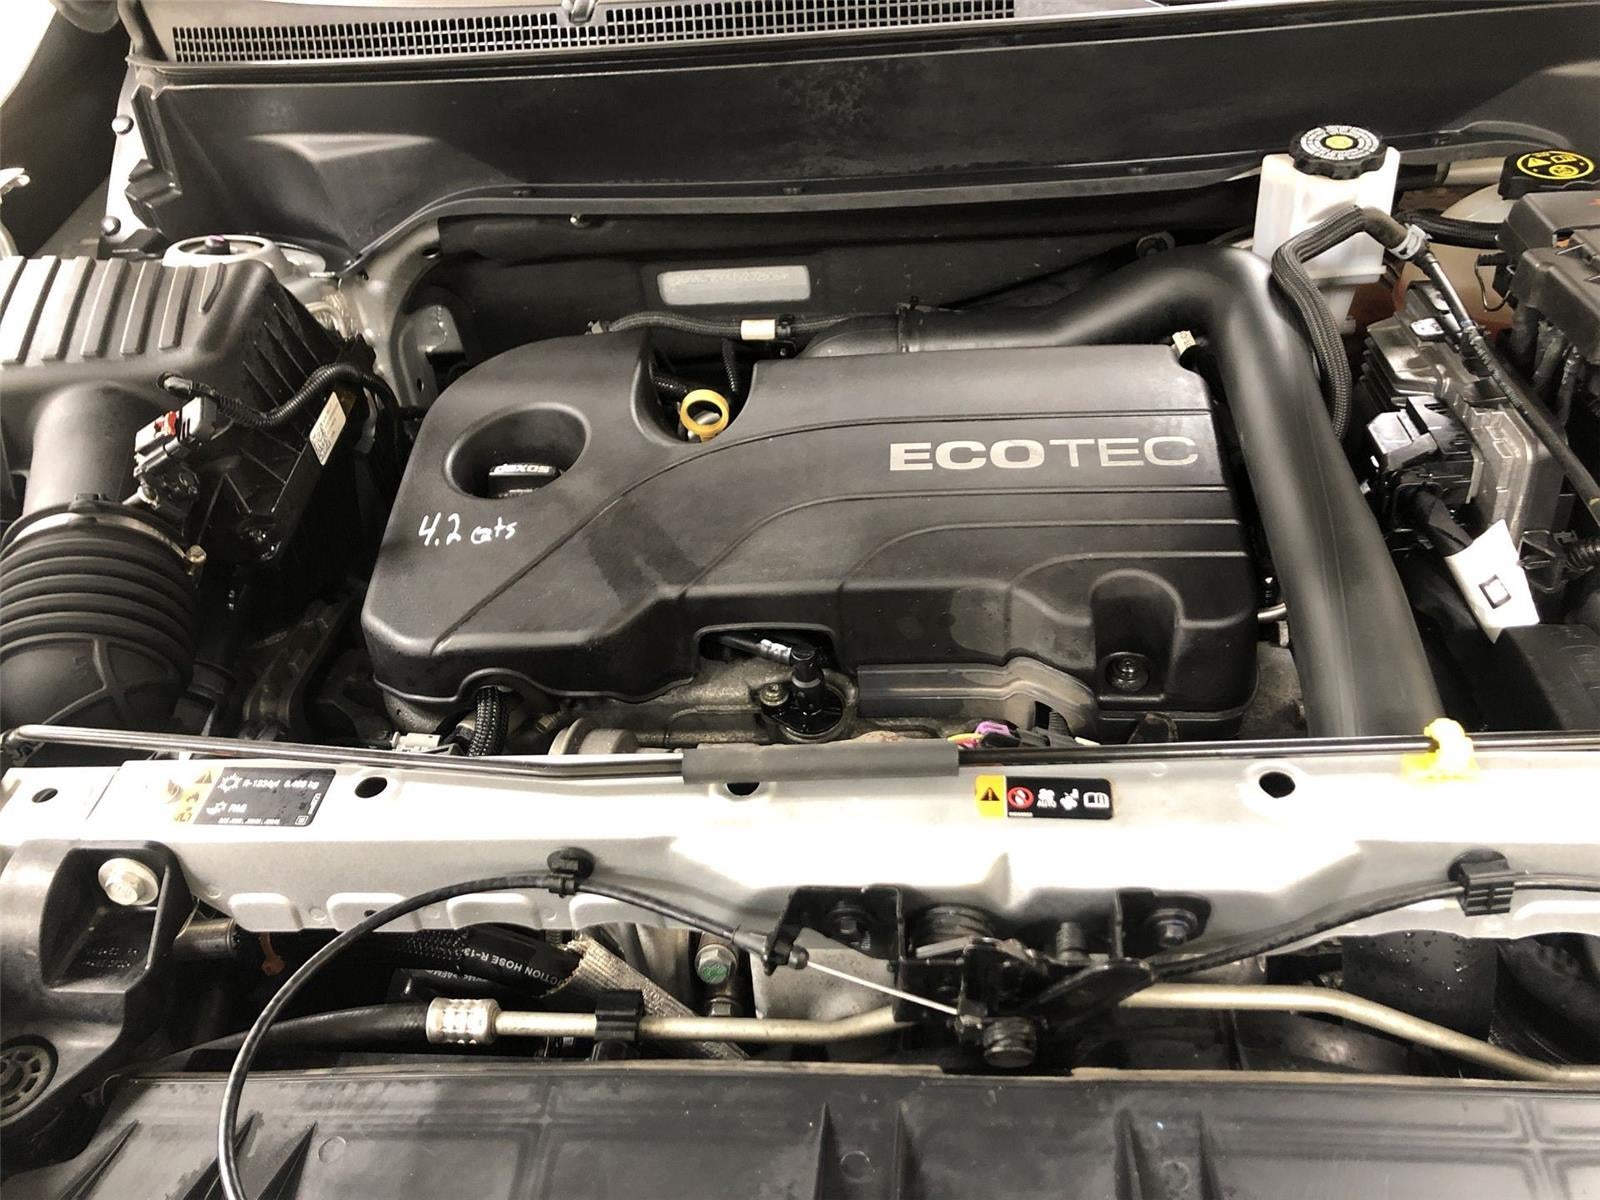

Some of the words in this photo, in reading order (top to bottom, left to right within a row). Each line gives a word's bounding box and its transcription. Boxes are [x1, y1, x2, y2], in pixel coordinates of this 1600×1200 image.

[889, 436, 1199, 471] ECOTEC
[418, 512, 462, 547] 4.2
[461, 947, 490, 962] R-13
[491, 954, 523, 972] HOSE
